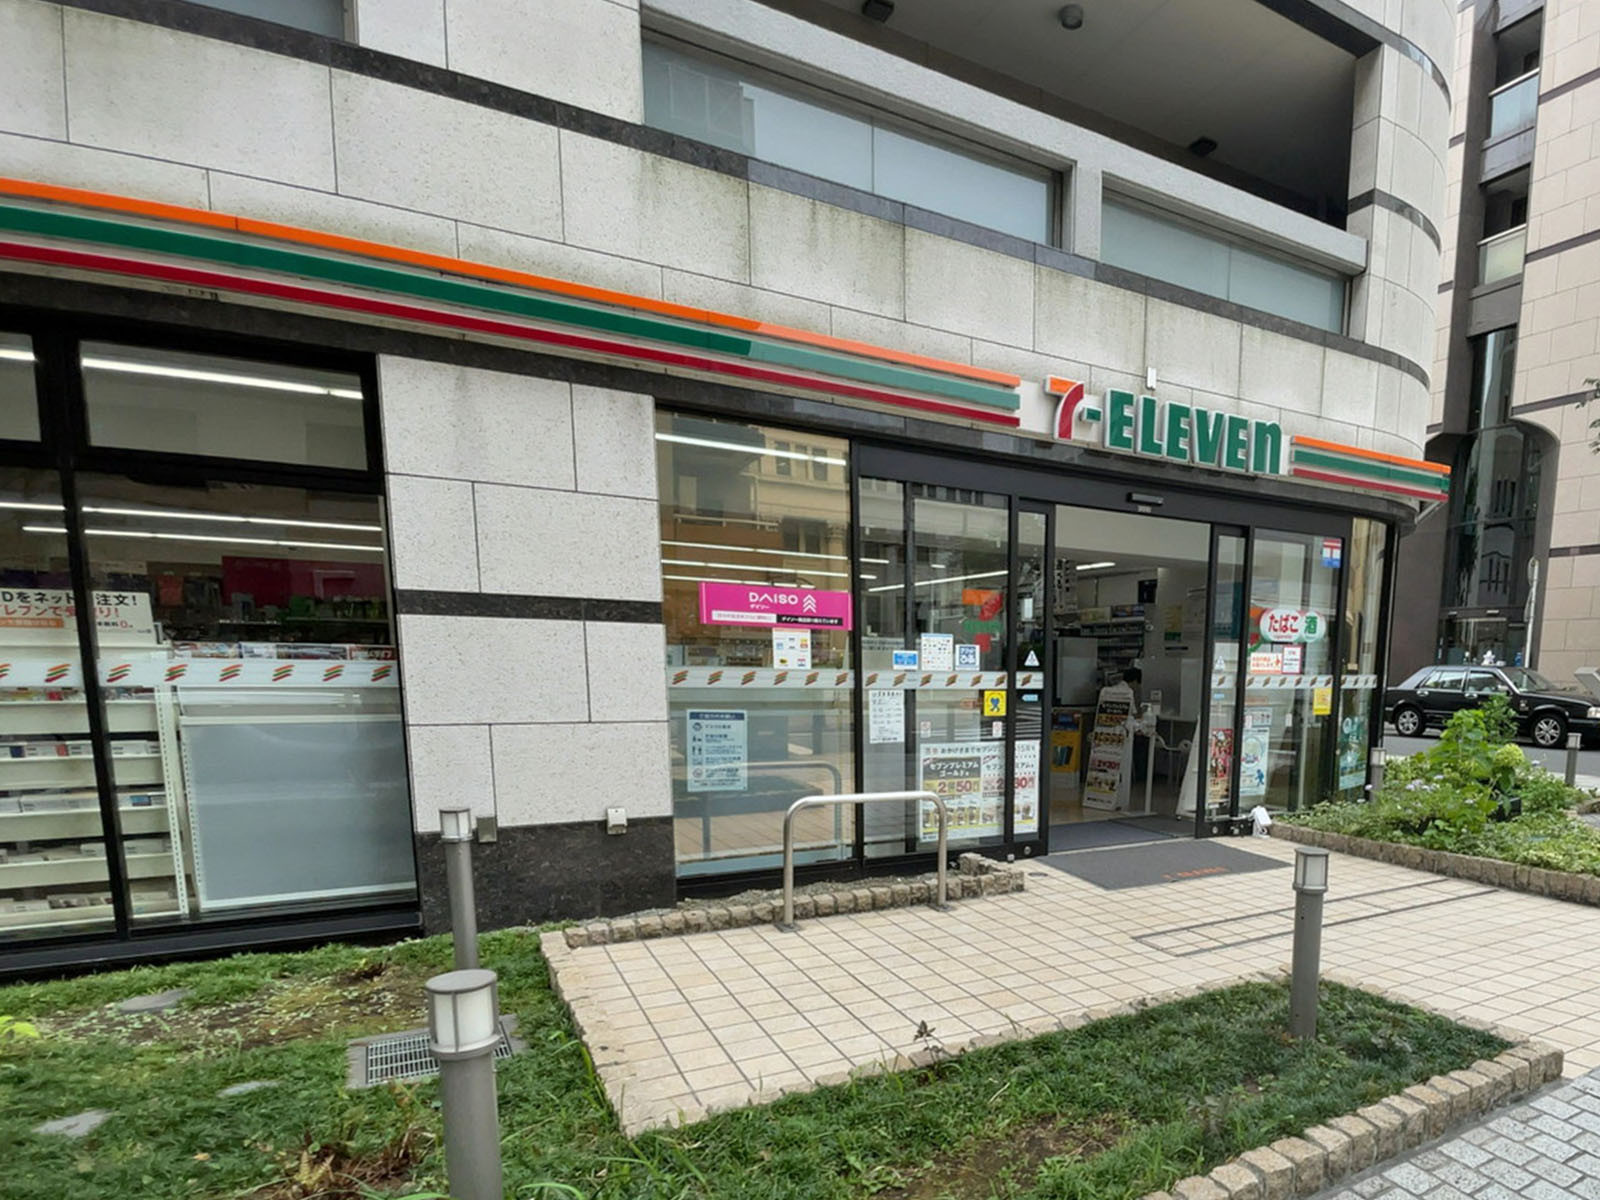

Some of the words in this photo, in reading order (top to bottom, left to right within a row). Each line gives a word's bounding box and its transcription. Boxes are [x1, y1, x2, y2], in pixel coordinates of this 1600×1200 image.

[748, 592, 799, 605] DAISO
[1267, 613, 1299, 633] たばこ
[1304, 615, 1318, 634] 酒
